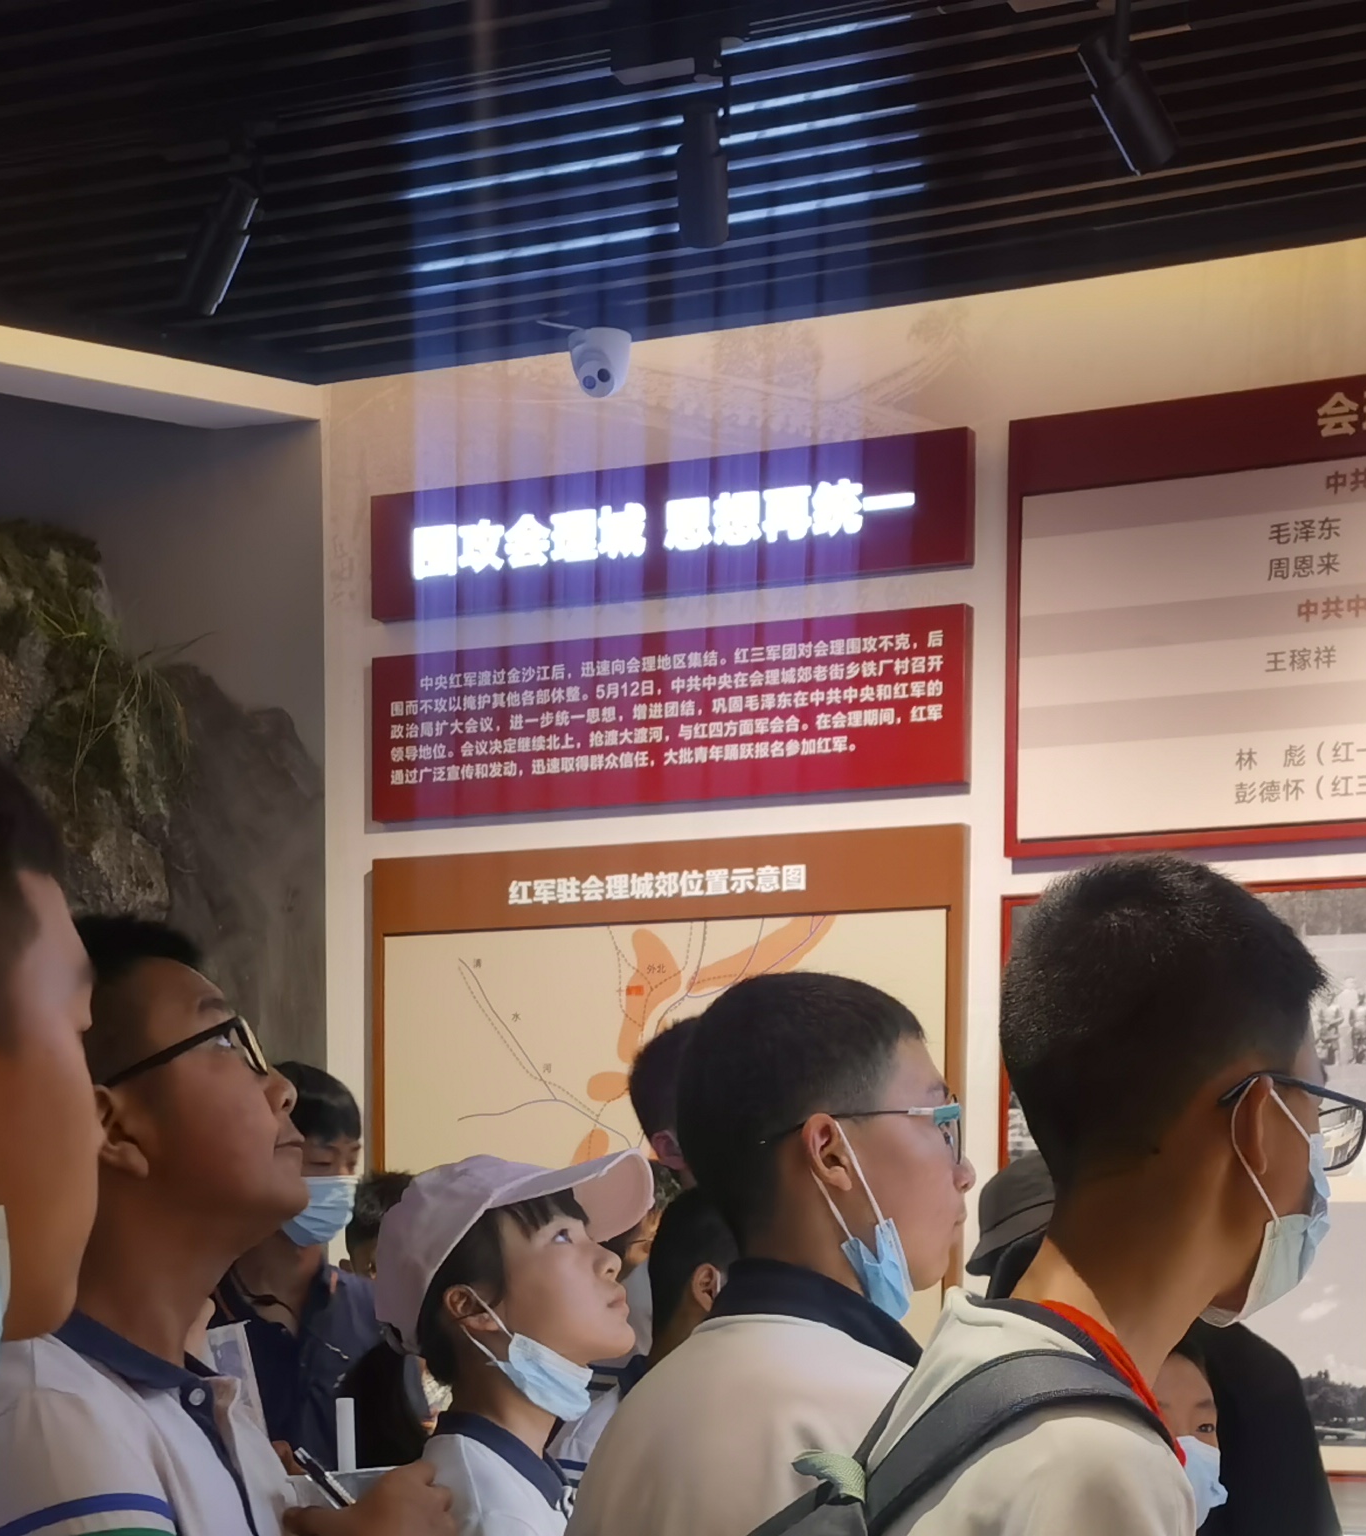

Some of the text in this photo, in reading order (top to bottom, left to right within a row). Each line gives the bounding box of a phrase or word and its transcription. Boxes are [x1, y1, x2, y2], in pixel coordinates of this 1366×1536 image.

[1268, 517, 1342, 546] 毛泽东
[1267, 553, 1341, 582] 周恩来
[1265, 646, 1337, 674] 王稼祥
[507, 863, 807, 905] 红军驻会理城郊位置示意图
